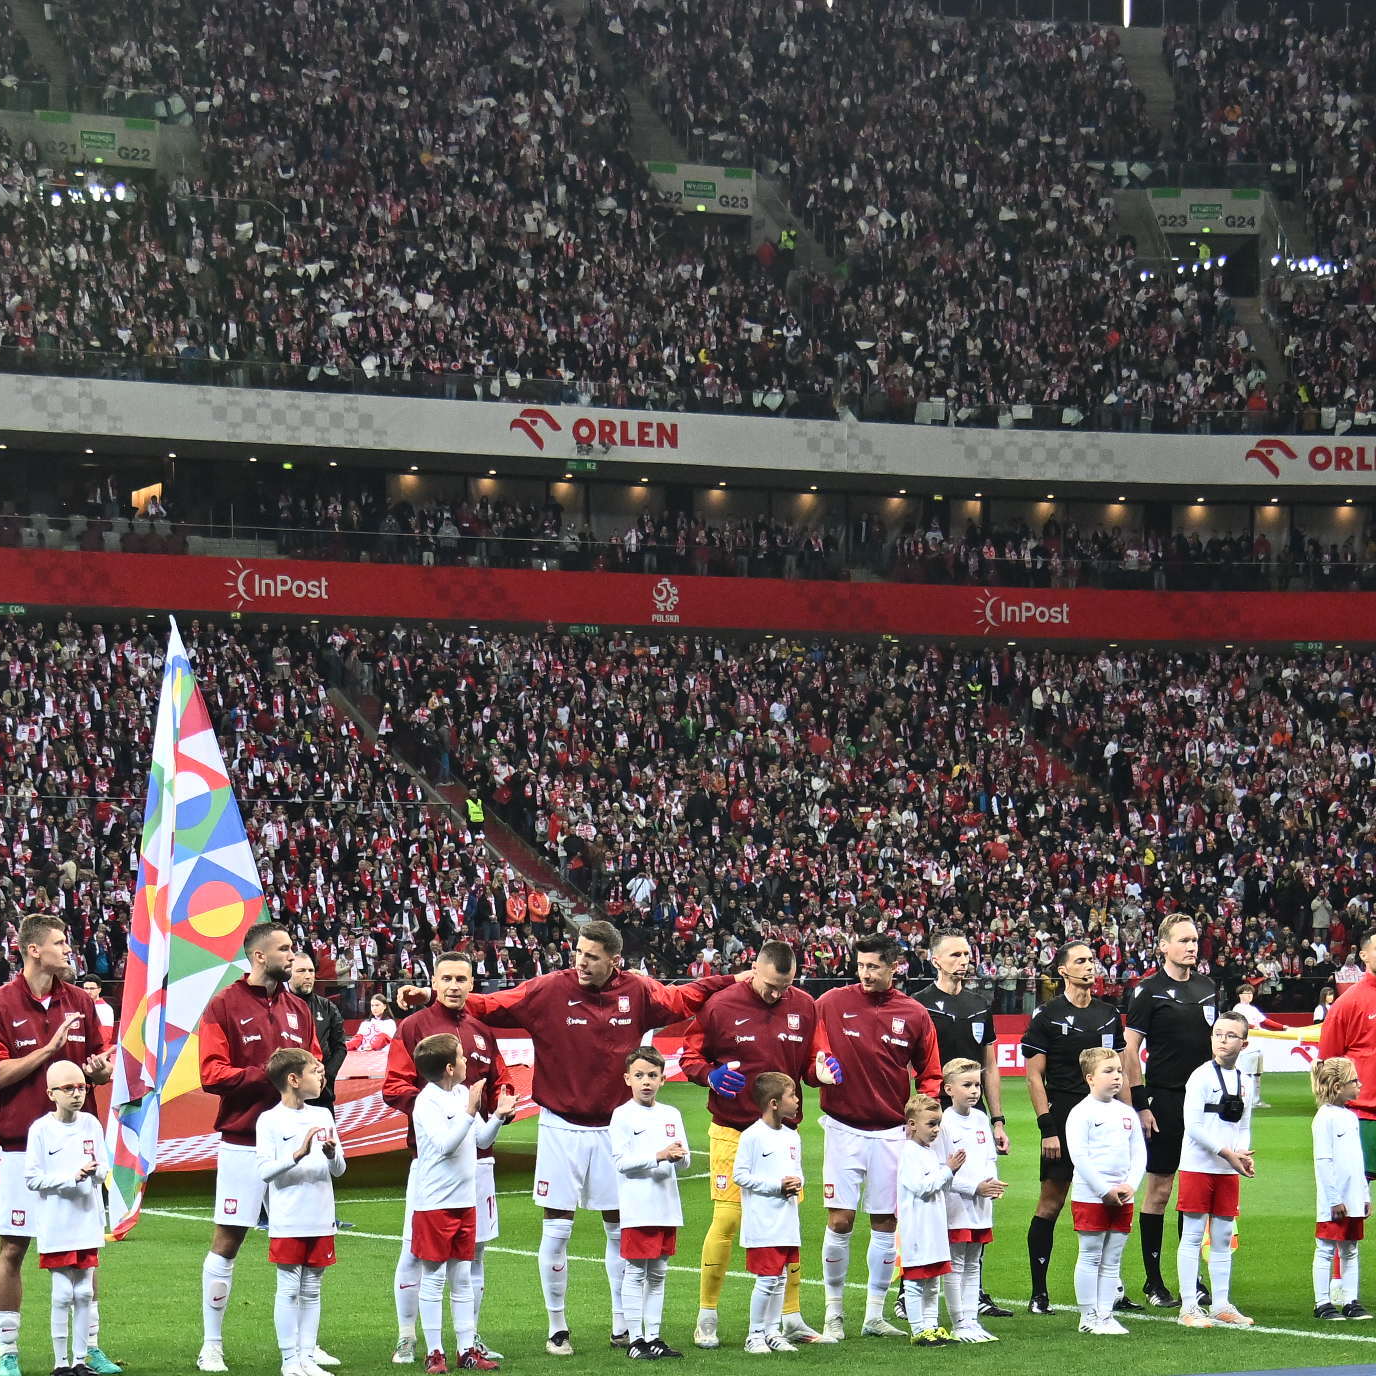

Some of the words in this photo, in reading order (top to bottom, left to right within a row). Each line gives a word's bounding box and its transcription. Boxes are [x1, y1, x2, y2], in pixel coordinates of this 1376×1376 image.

[118, 146, 151, 163] G22
[719, 193, 749, 209] G23
[1158, 213, 1188, 228] G23
[1224, 215, 1256, 230] G24
[572, 417, 680, 450] ORLEN
[255, 573, 330, 600] InPost
[651, 613, 680, 624] POLSKA
[1000, 600, 1070, 625] InPost
[486, 1195, 495, 1220] 1
